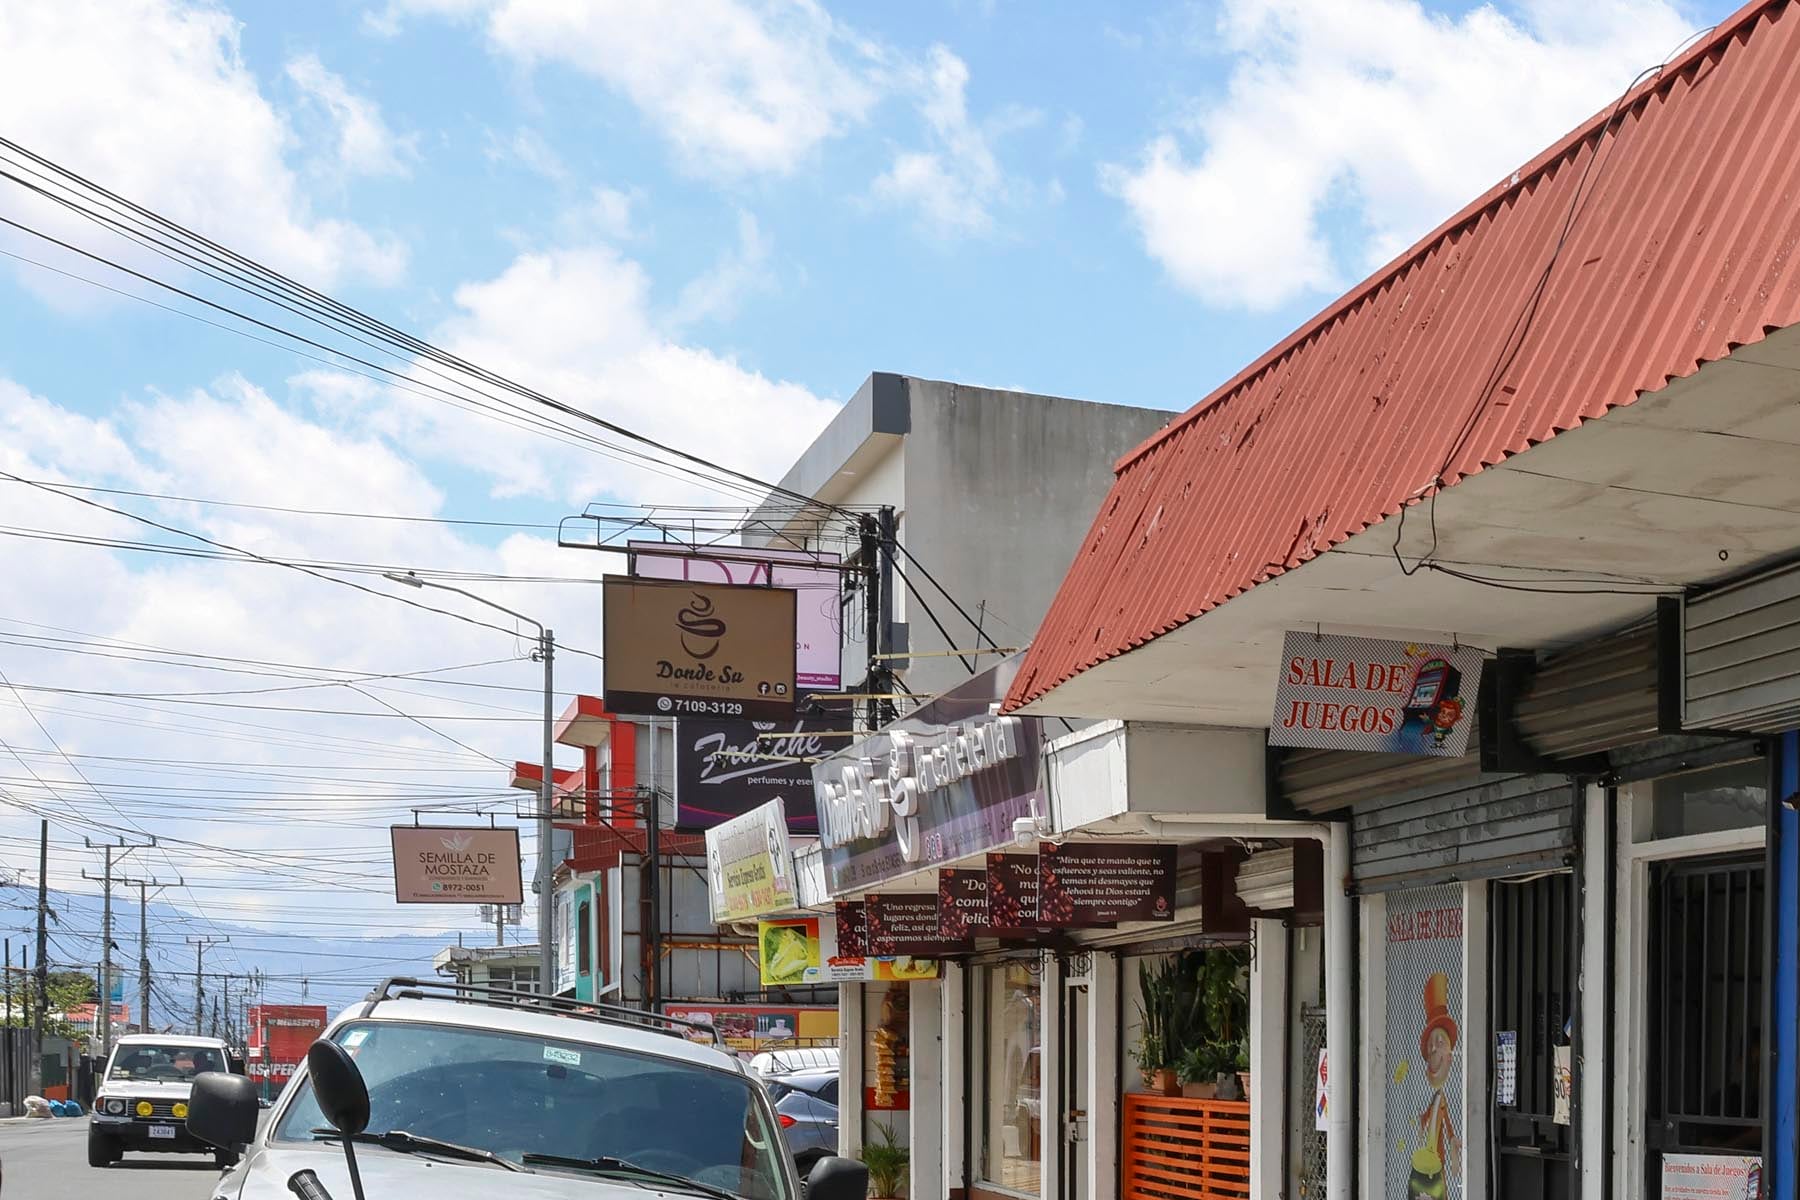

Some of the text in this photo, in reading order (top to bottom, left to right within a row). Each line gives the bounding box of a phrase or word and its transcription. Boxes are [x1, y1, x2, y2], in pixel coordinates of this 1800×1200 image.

[656, 659, 744, 684] Donde Su
[1287, 655, 1407, 694] SALA DE
[675, 700, 743, 715] 7109-3129
[1283, 700, 1397, 735] JUEGOS
[747, 775, 787, 785] perfumes
[788, 778, 795, 786] y
[419, 852, 496, 864] SEMILLA DE
[1081, 858, 1097, 867] que
[1106, 857, 1135, 865] mando
[1136, 858, 1151, 867] que
[425, 864, 490, 875] MOSTAZA
[1097, 878, 1138, 887] desmayes
[1139, 879, 1155, 887] que
[442, 884, 485, 892] 8972-0051
[1105, 887, 1124, 896] Dios
[1073, 898, 1102, 907] siempre
[904, 904, 936, 912] regresa
[883, 913, 915, 922] lugares
[876, 934, 923, 943] esperamos
